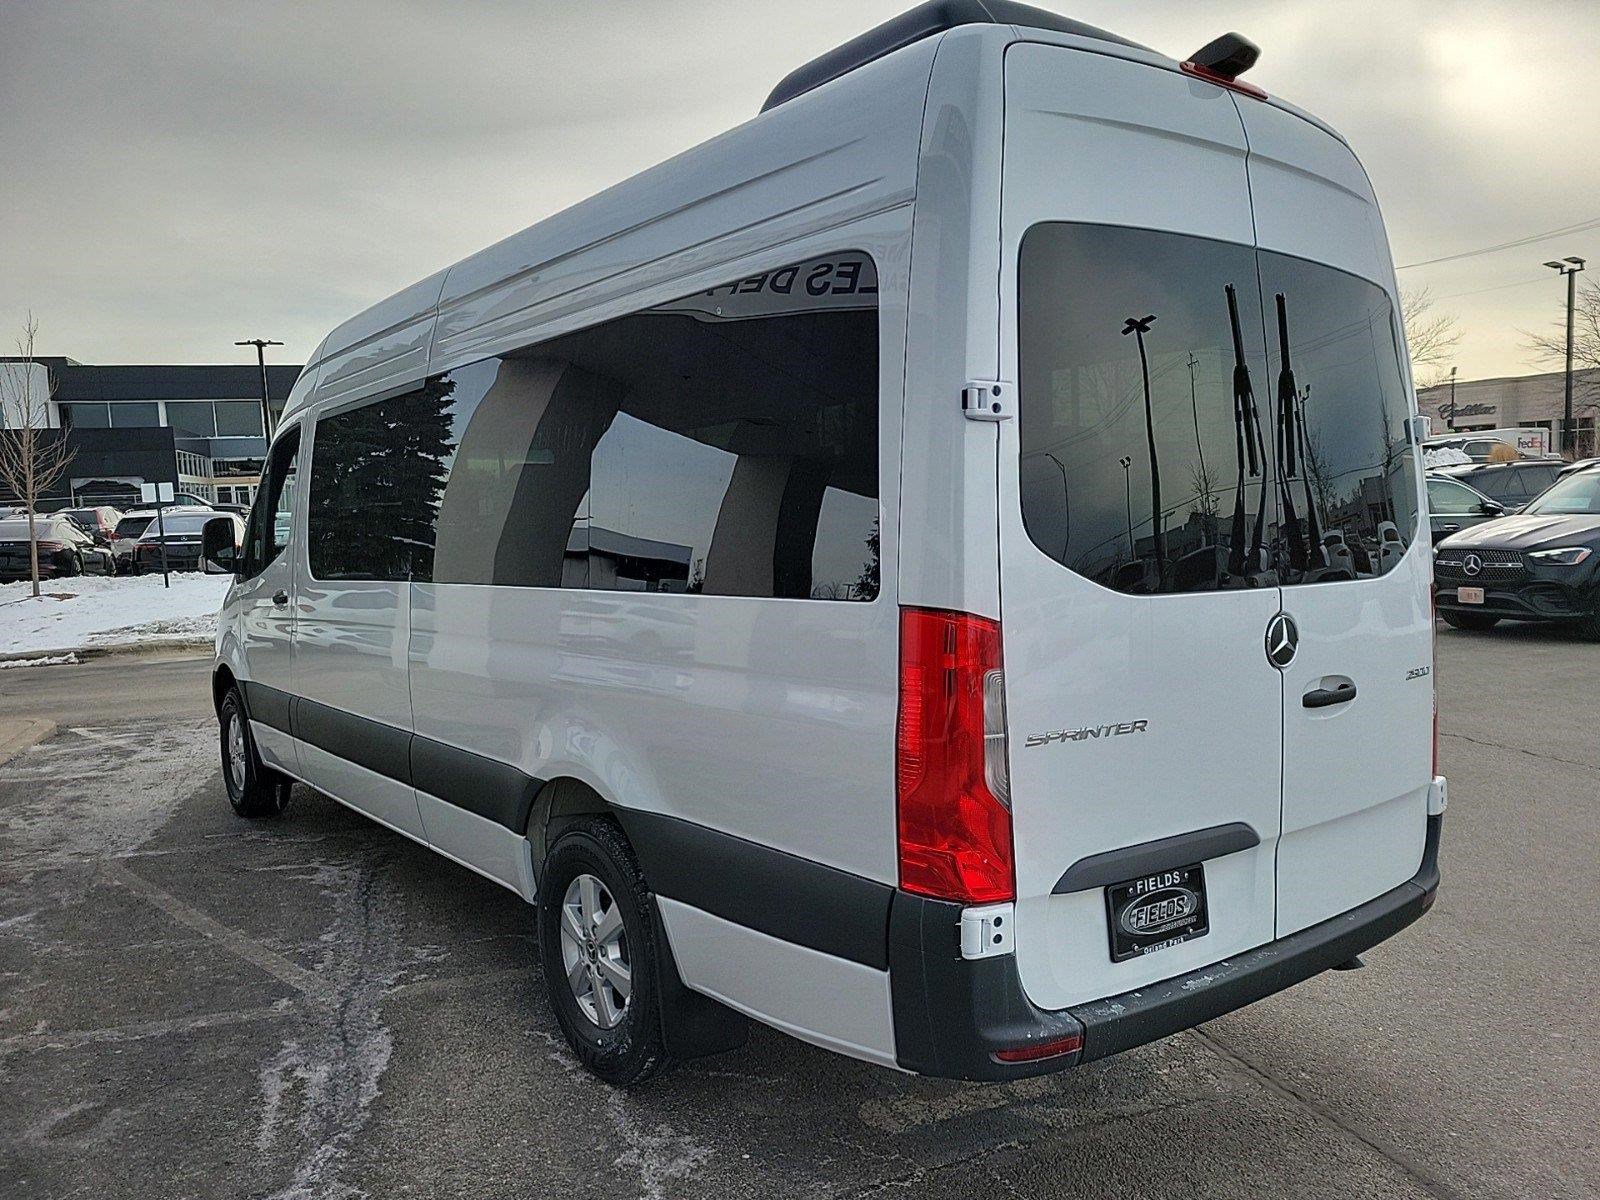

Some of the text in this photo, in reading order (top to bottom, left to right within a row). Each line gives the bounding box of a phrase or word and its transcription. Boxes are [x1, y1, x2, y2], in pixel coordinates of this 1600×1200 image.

[1518, 437, 1547, 448] FedEx
[1025, 719, 1148, 748] SPRINTER
[1137, 871, 1180, 893] FIELDS
[1135, 897, 1187, 927] FIELDS
